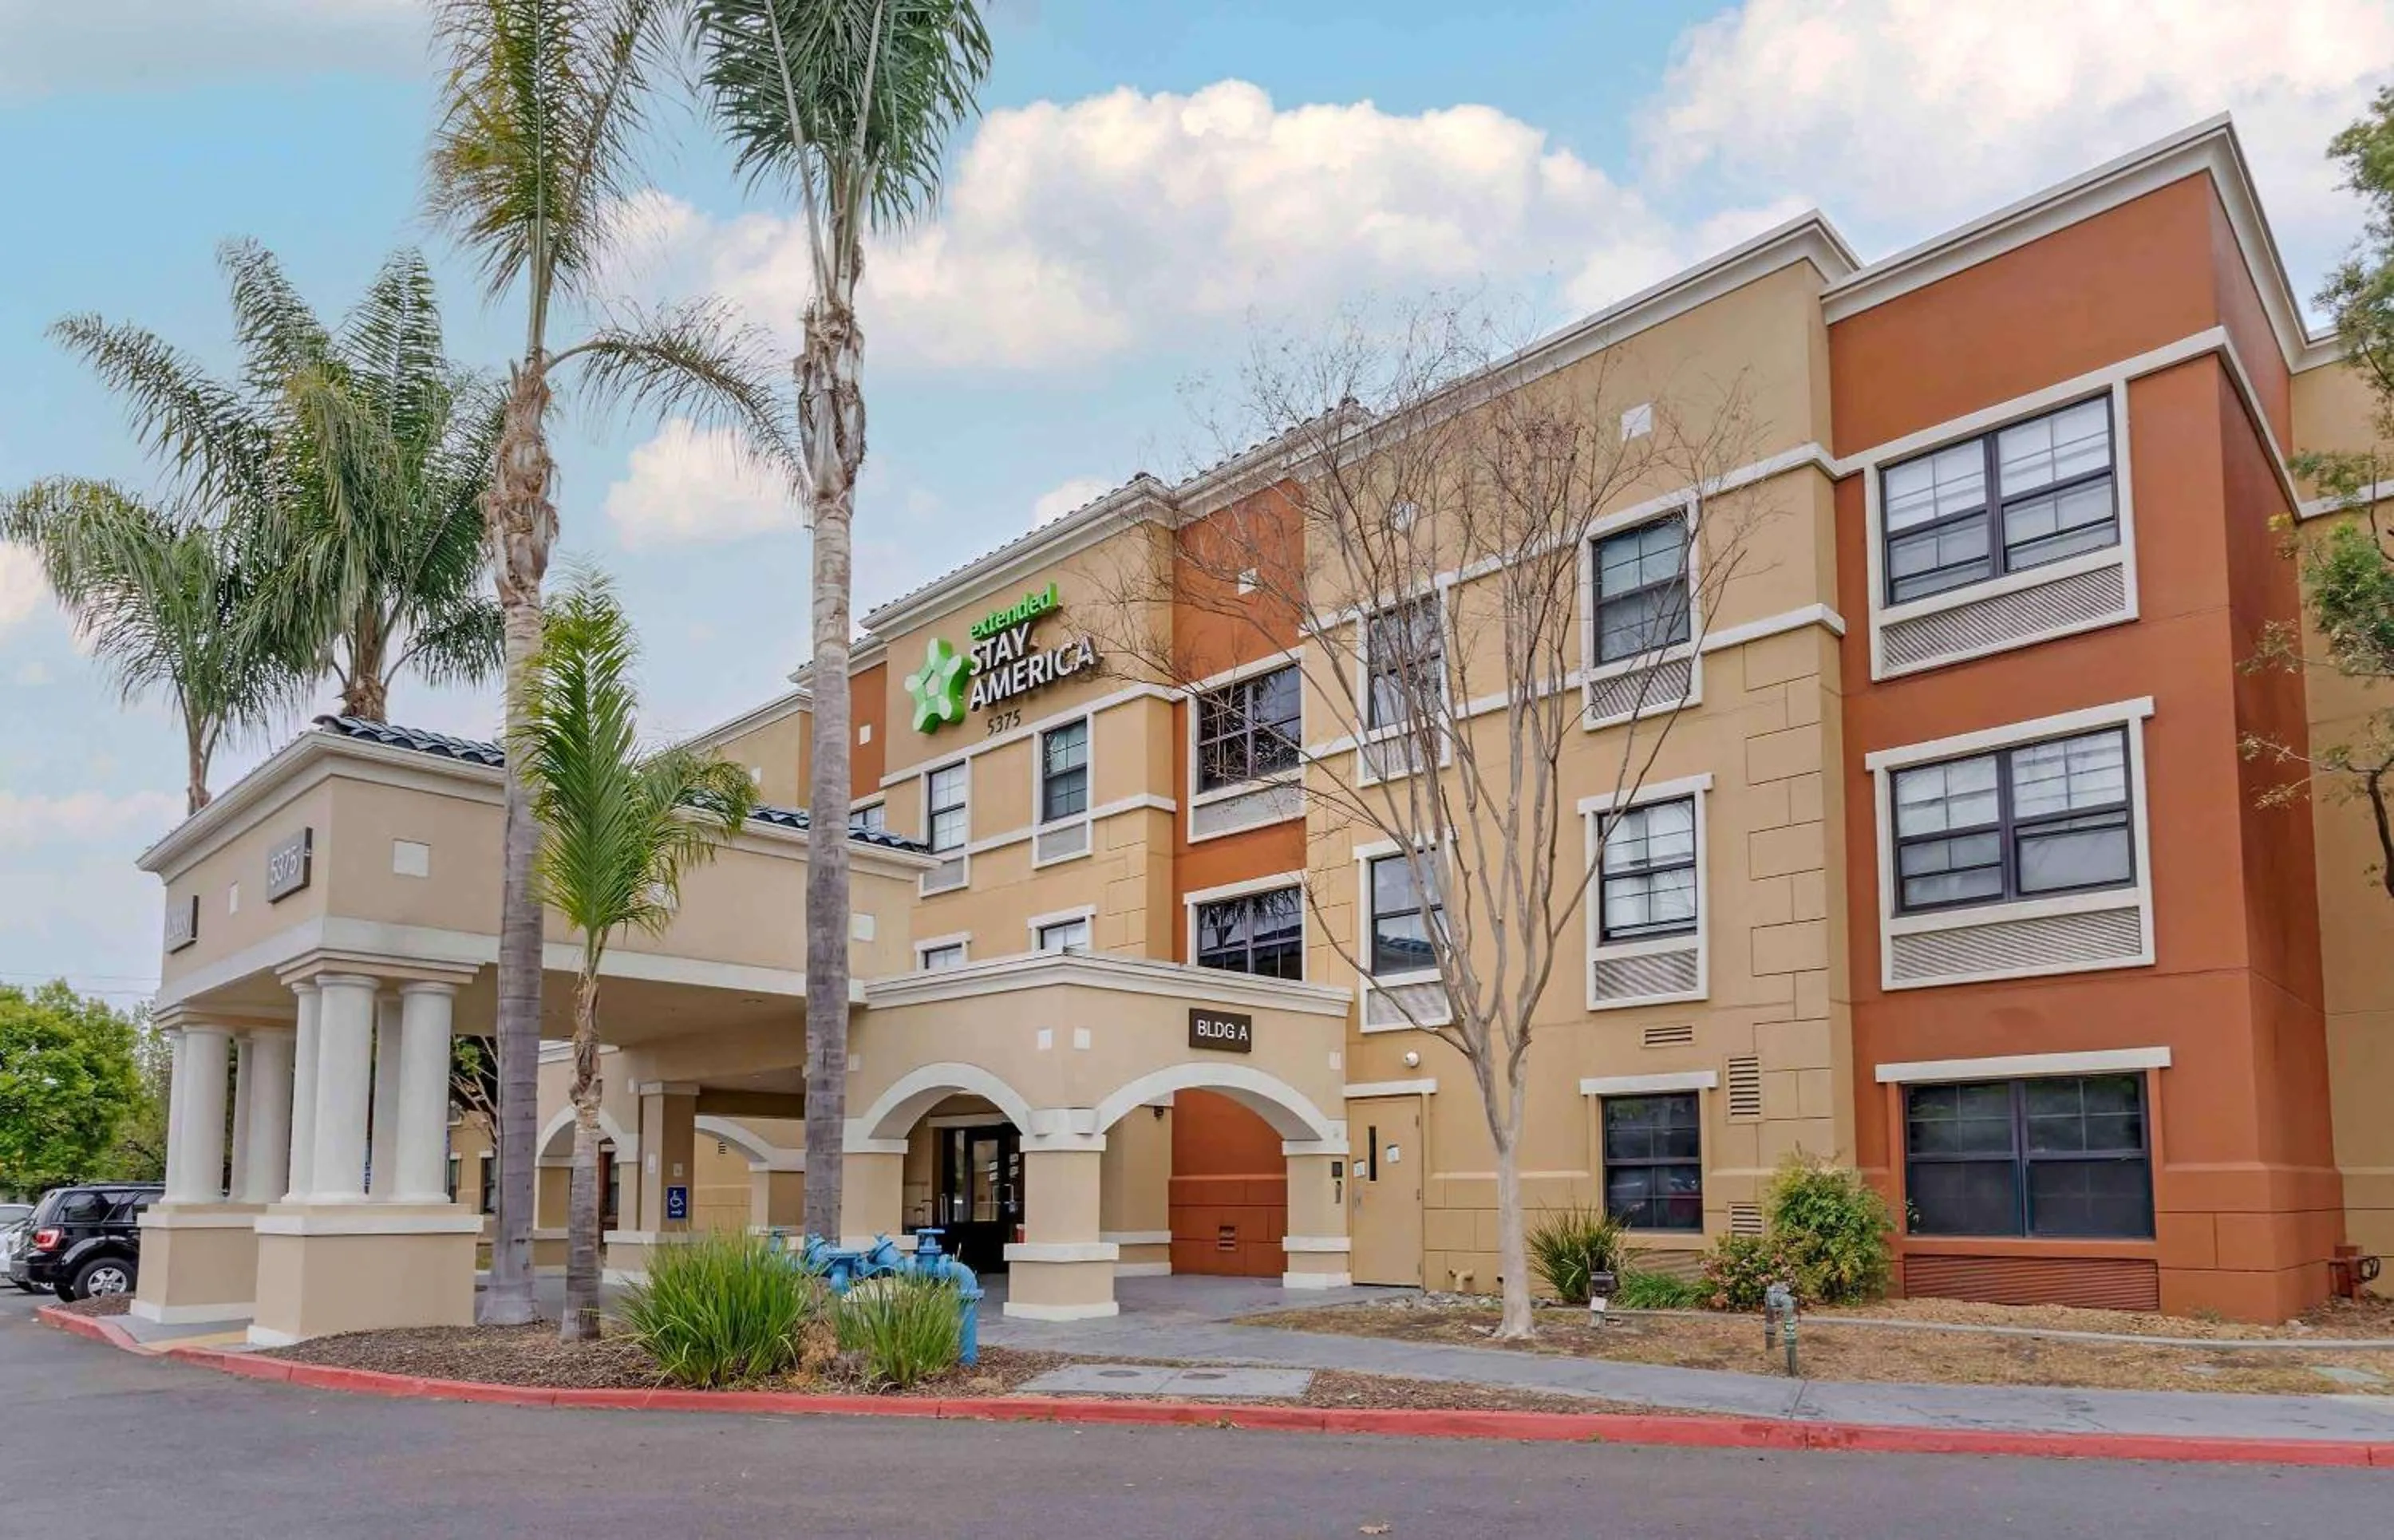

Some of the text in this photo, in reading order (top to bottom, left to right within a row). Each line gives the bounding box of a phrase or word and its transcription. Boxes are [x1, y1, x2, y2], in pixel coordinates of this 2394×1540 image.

[970, 580, 1057, 639] extended
[969, 622, 1033, 677] STAY
[970, 636, 1096, 710] AMERICA
[986, 709, 1021, 737] 5375
[1197, 1019, 1249, 1040] BLDG A
